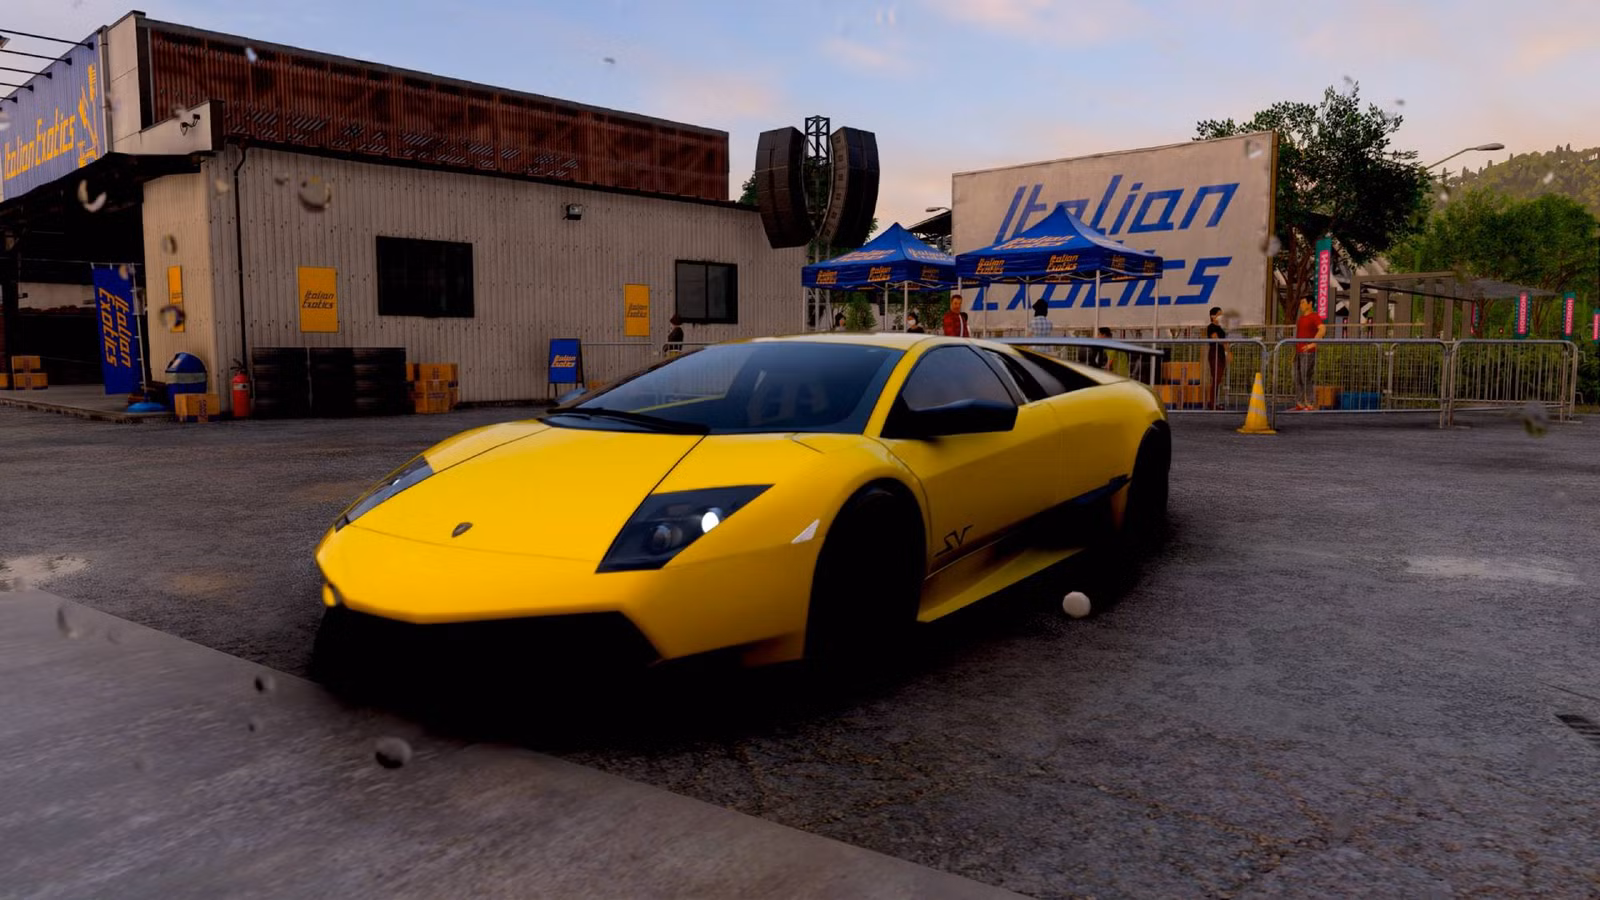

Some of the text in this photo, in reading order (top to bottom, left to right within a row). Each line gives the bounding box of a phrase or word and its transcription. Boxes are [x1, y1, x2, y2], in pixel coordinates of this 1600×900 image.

[4, 107, 76, 180] Italian Exotics
[302, 299, 334, 309] Exotics
[305, 290, 335, 300] Italian
[1318, 253, 1329, 317] HORIZON
[99, 288, 118, 367] Exotics
[115, 295, 132, 368] Italian
